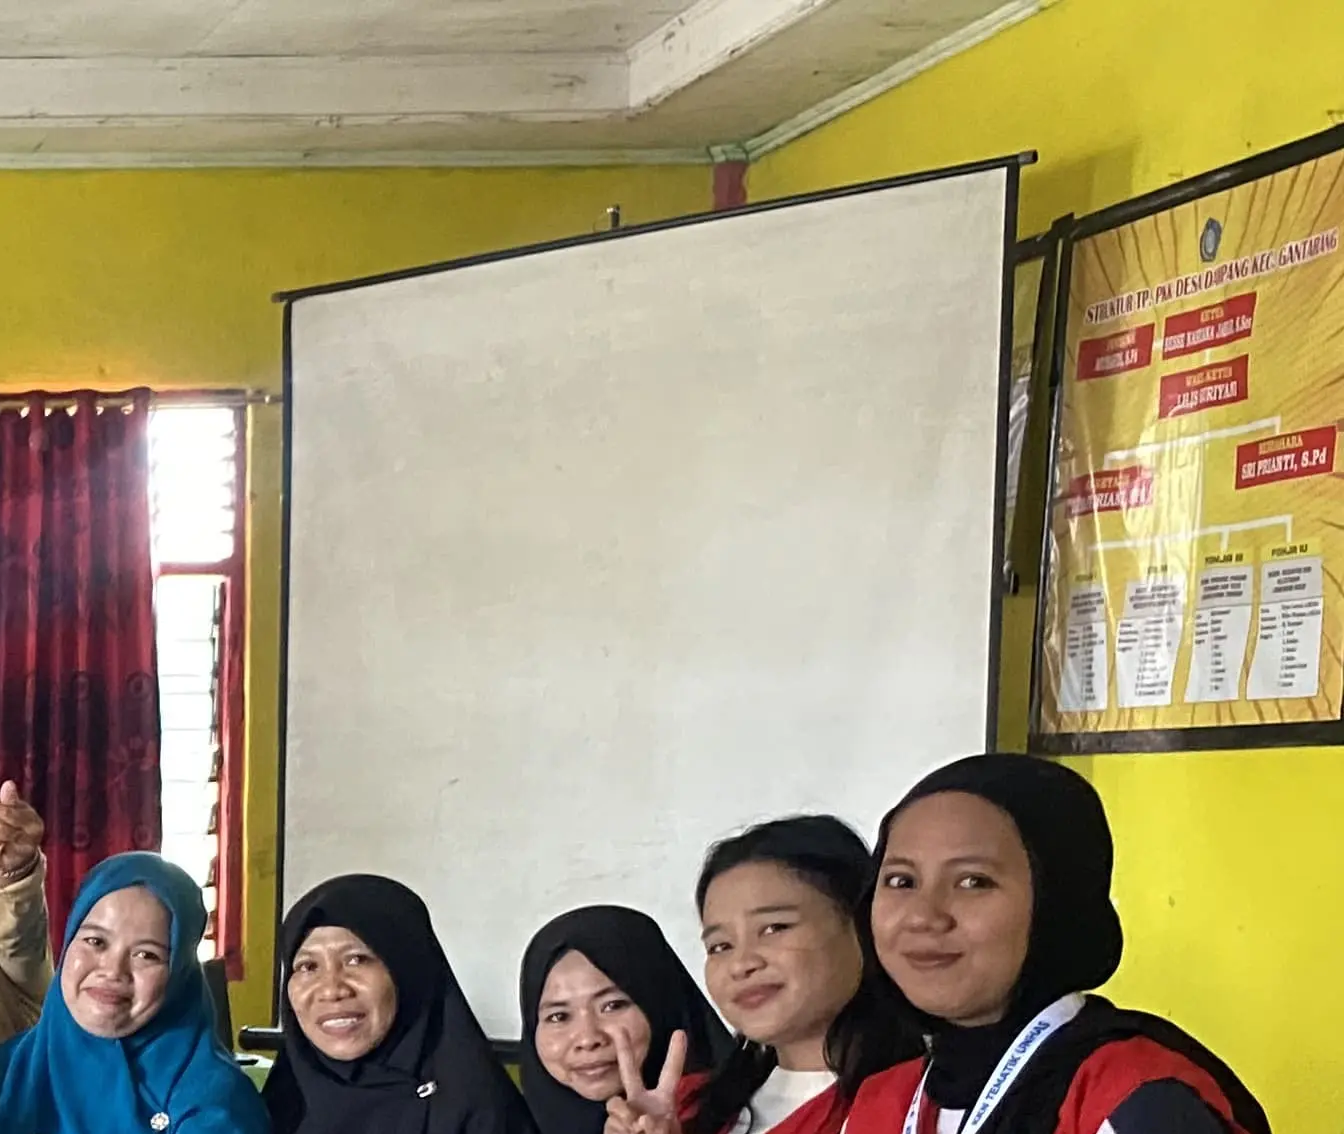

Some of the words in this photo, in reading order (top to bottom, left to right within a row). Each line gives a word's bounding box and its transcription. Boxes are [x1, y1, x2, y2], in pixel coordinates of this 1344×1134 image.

[1242, 461, 1256, 480] SRI
[1301, 446, 1327, 468] S.Pd
[985, 1055, 1021, 1101] TEMATIK
[1015, 1020, 1051, 1055] UNHAS
